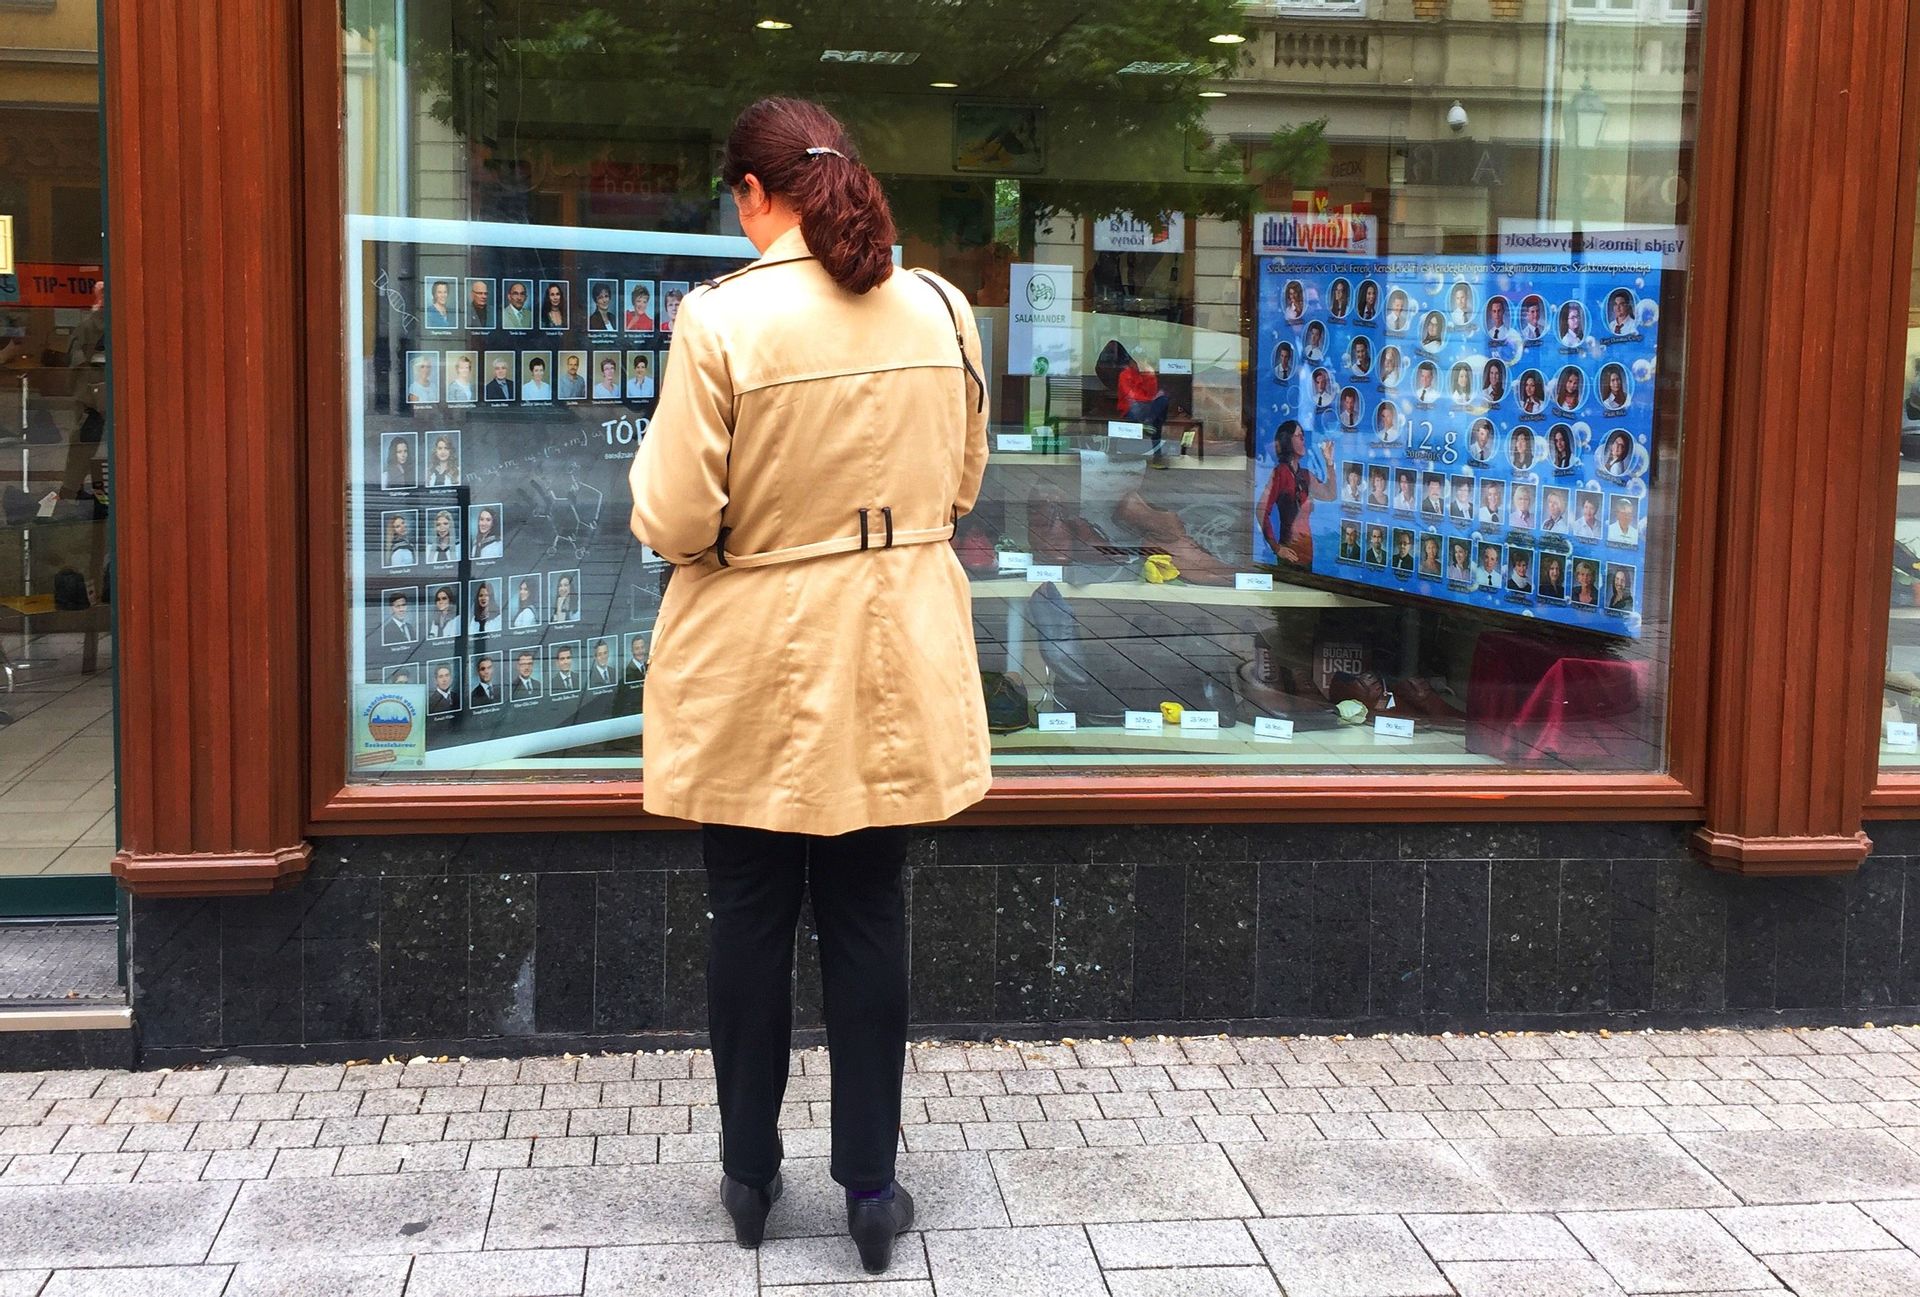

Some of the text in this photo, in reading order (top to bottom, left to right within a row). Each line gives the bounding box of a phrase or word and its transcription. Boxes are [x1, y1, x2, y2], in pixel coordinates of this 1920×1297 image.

[1015, 314, 1066, 323] SALAMANDER
[1322, 647, 1363, 658] BUGATTI
[1322, 659, 1363, 674] USED
